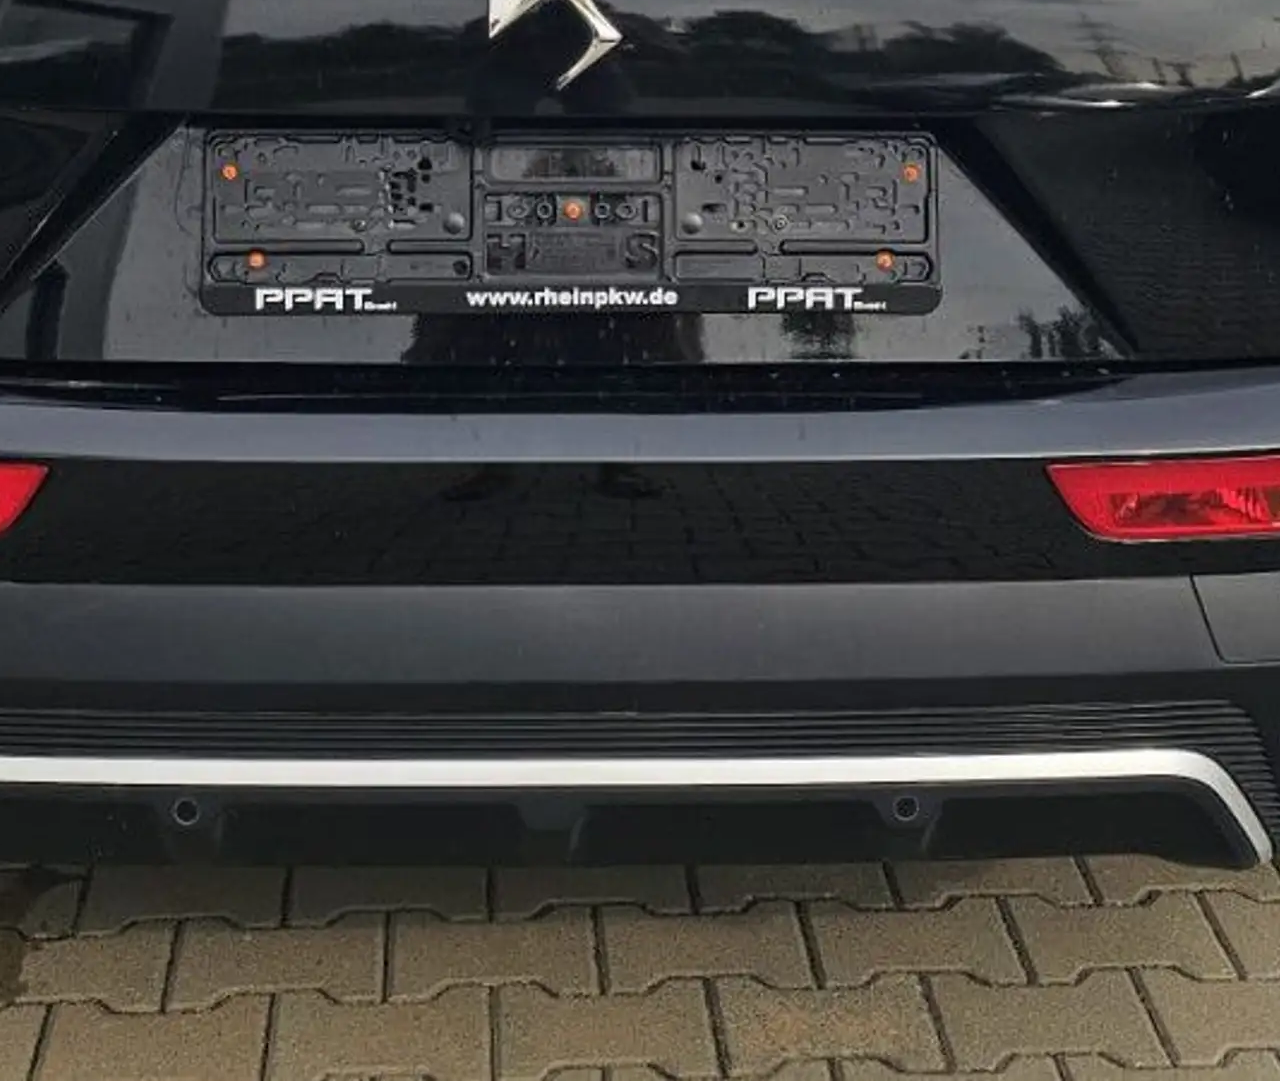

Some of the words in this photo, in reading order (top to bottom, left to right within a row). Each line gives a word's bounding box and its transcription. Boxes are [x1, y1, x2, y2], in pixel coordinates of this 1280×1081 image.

[255, 287, 373, 311] PPAT
[465, 287, 679, 310] www.rheinpkw.de
[747, 287, 864, 310] PPAT
